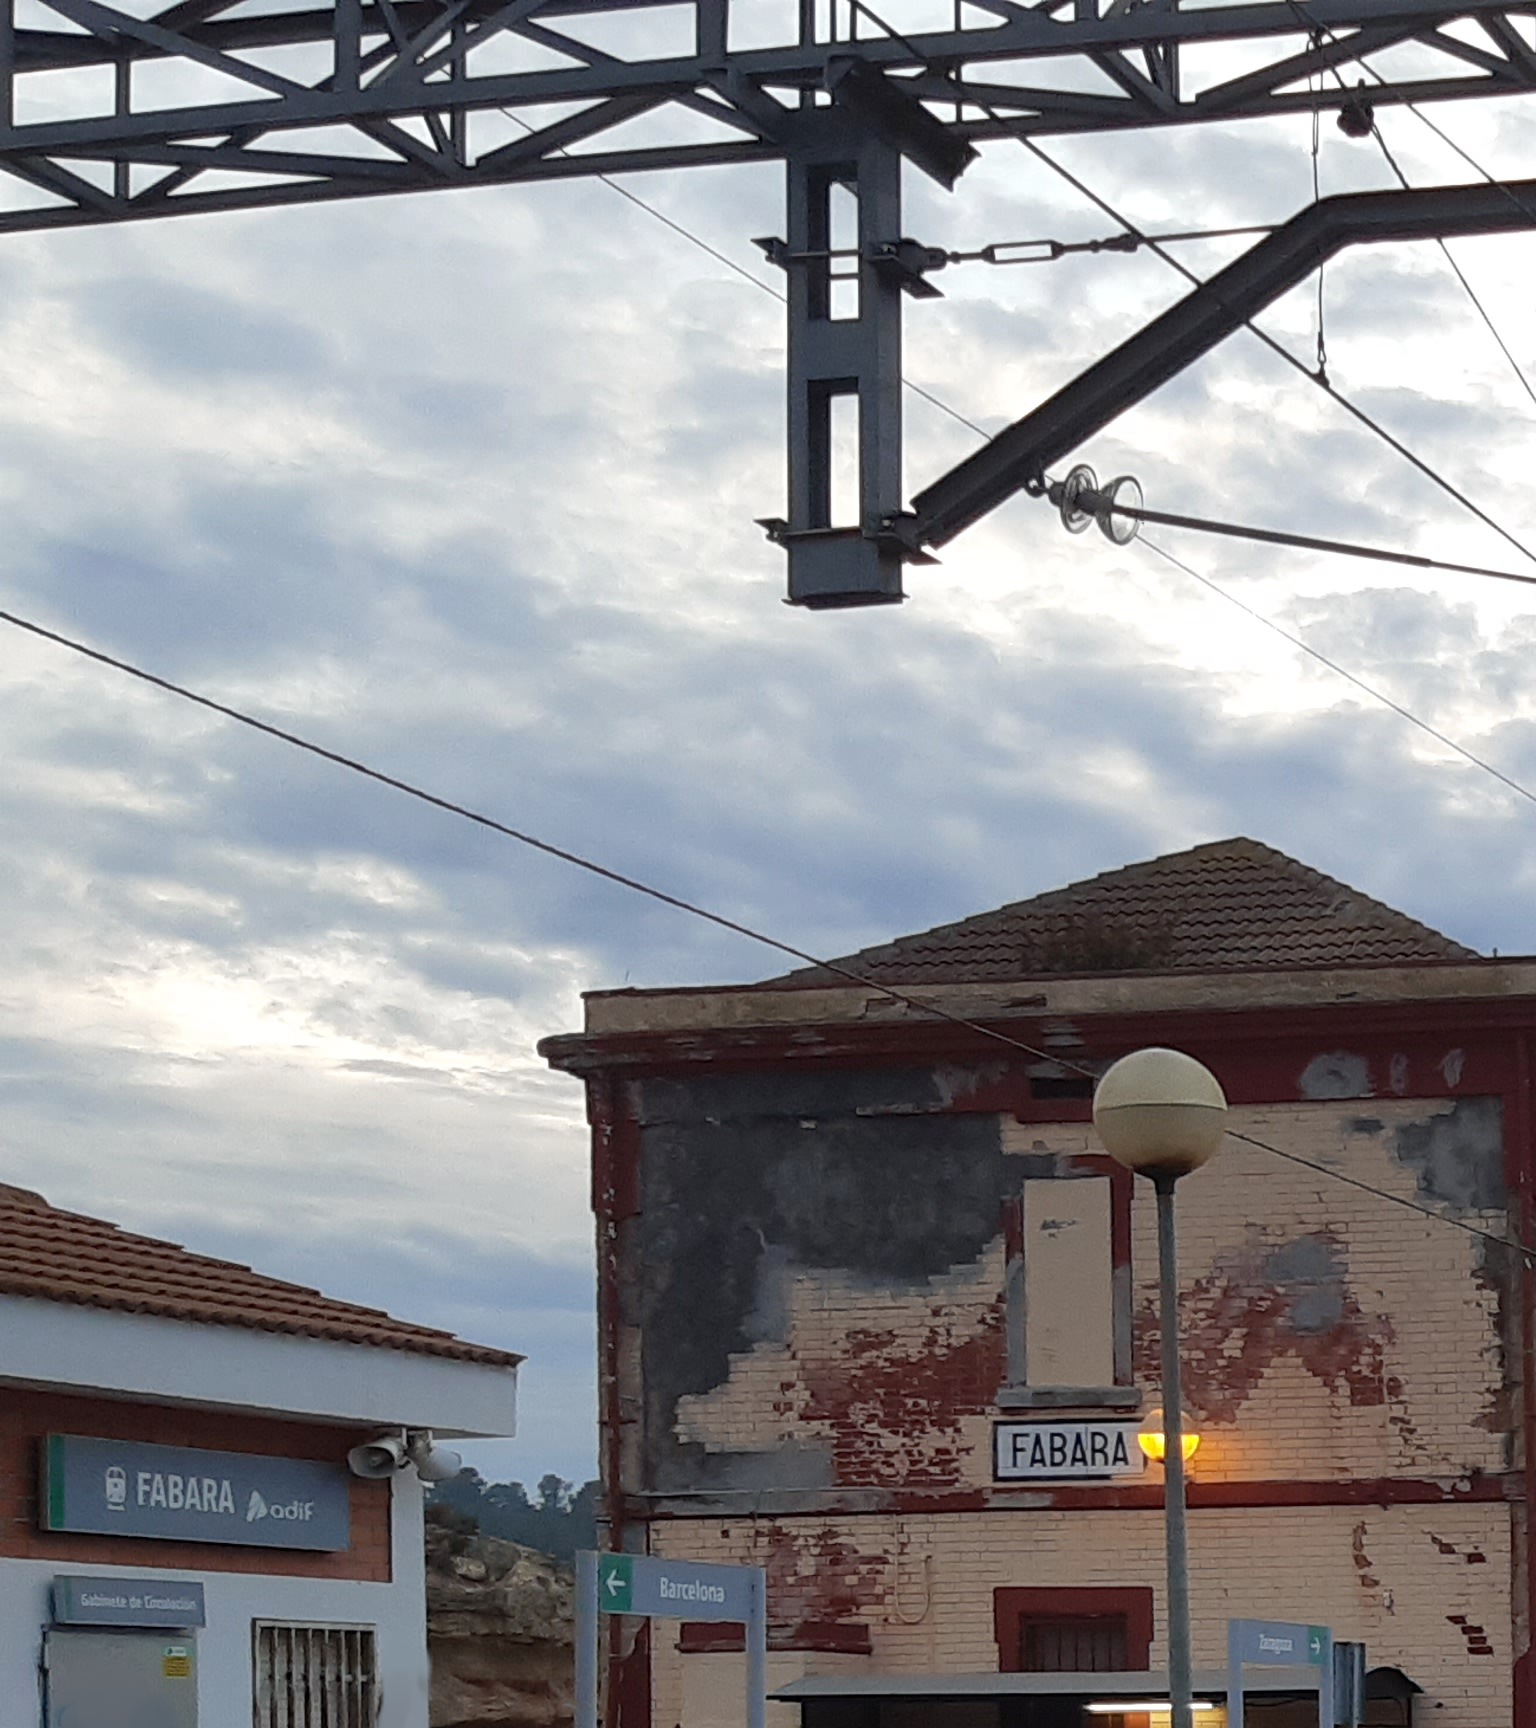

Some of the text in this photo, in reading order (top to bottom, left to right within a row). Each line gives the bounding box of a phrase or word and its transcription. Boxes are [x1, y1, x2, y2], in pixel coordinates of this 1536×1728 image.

[1012, 1431, 1129, 1468] FABARA
[137, 1471, 315, 1521] FABARA adif
[660, 1576, 725, 1603] Barcelona
